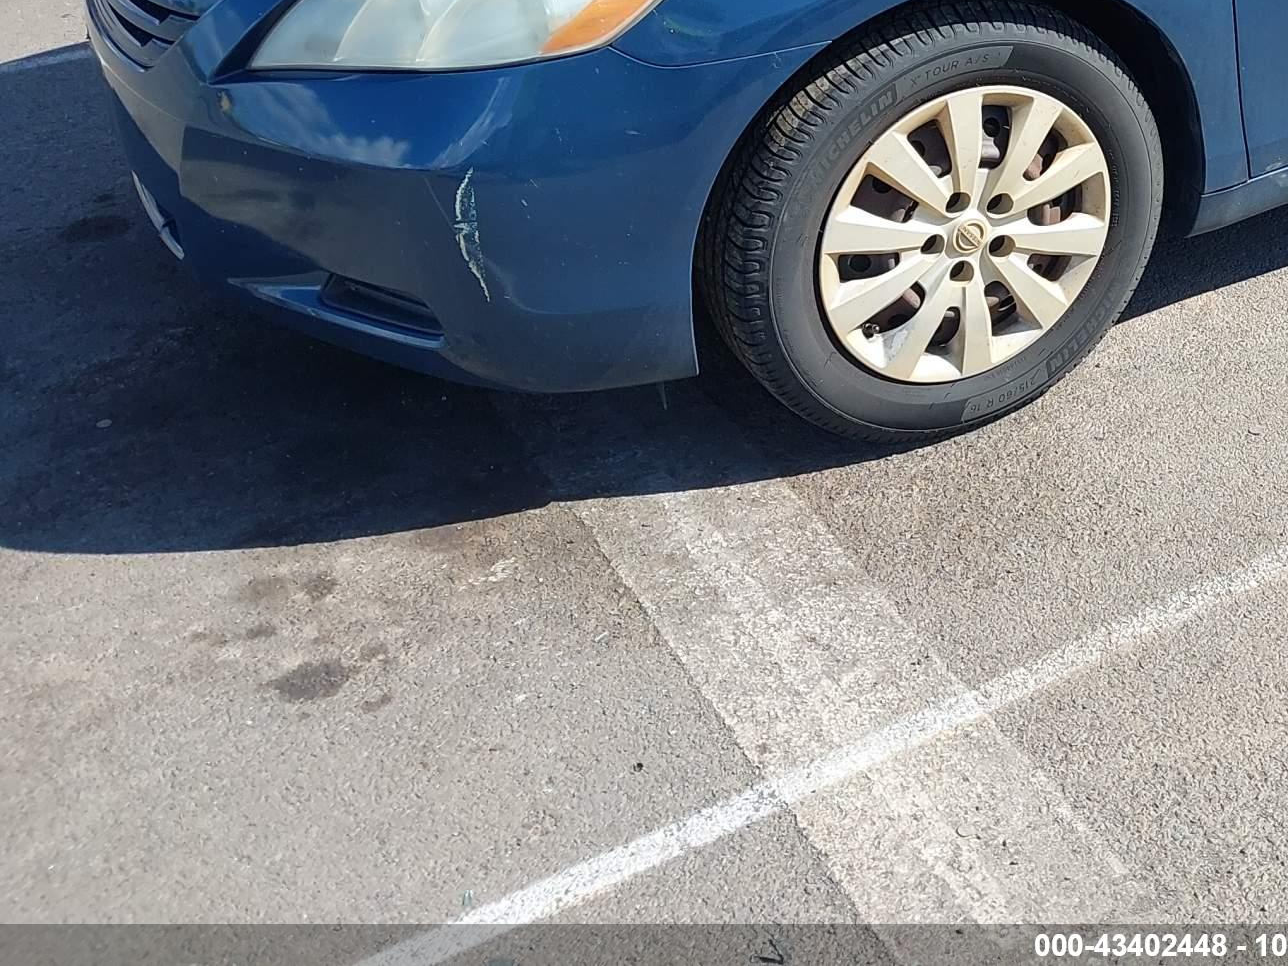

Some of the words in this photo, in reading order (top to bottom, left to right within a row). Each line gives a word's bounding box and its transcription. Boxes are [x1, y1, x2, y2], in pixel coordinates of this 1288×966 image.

[925, 60, 959, 81] TOUR
[965, 53, 989, 67] A/S
[999, 378, 1035, 403] 215/60
